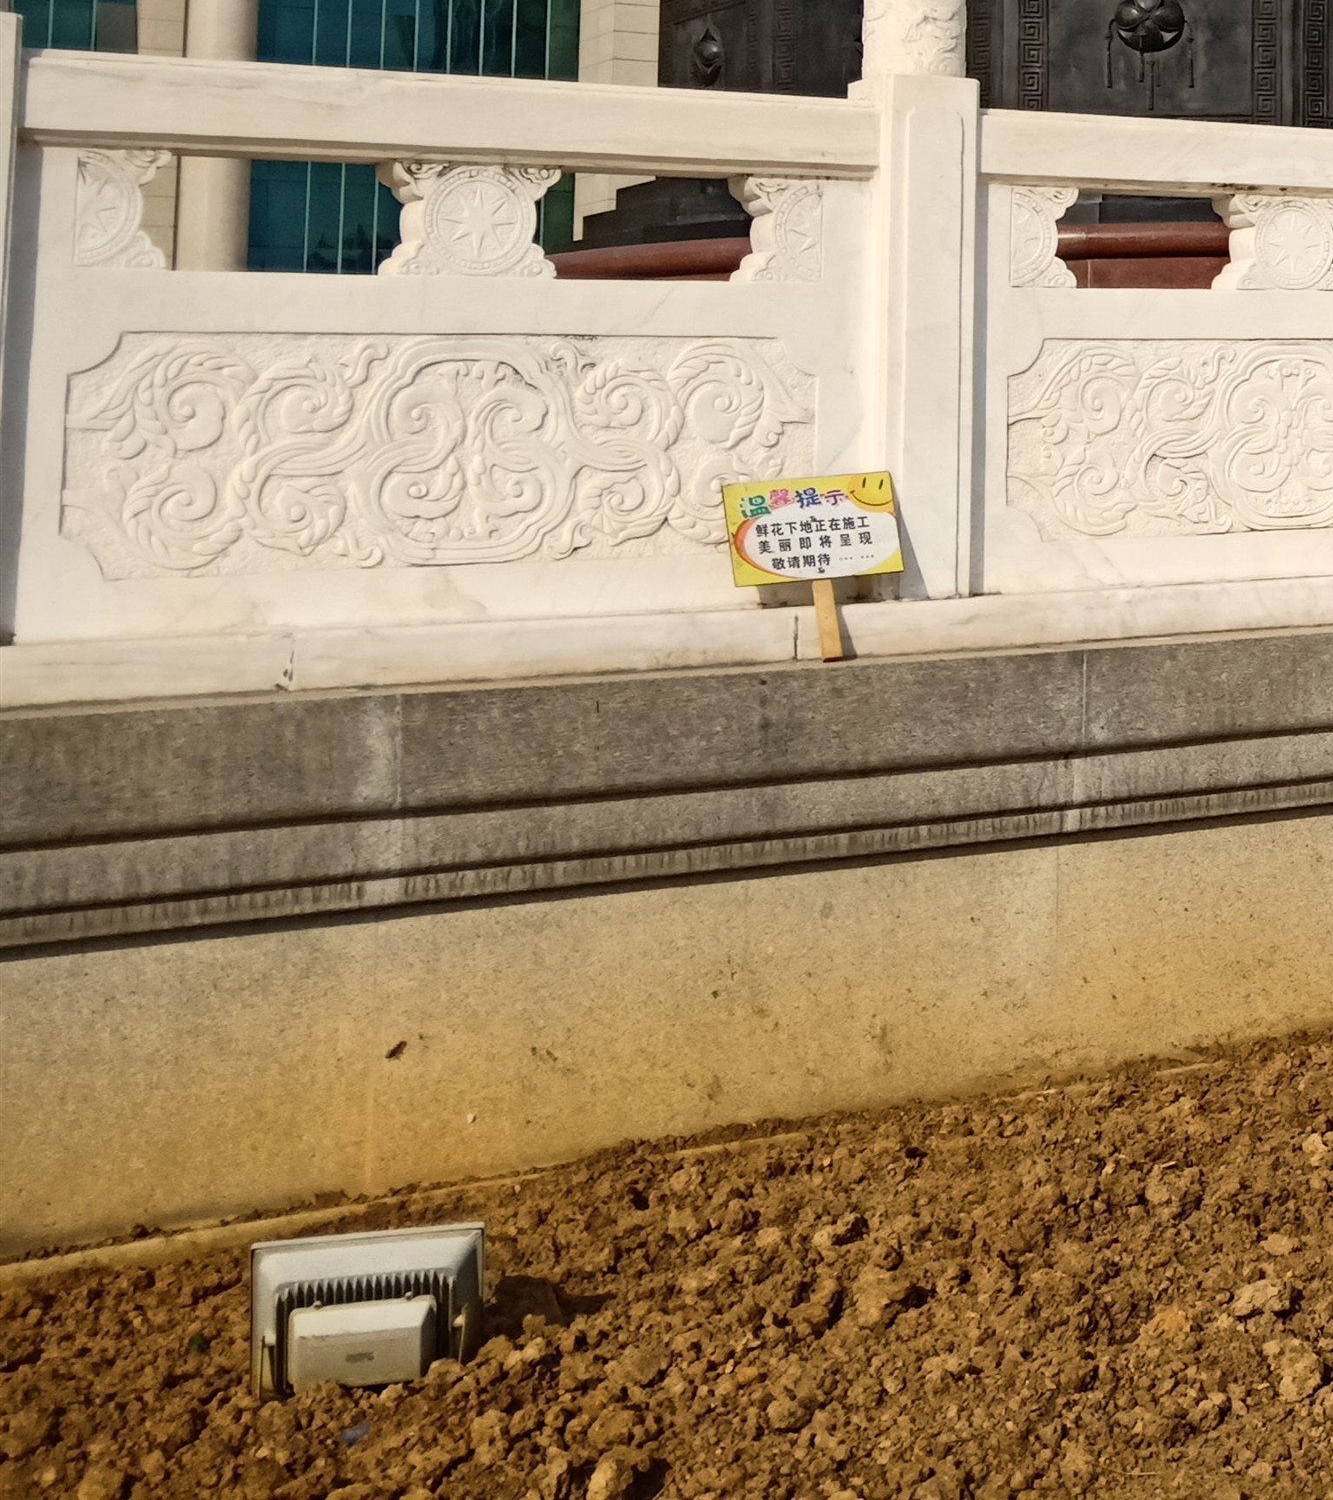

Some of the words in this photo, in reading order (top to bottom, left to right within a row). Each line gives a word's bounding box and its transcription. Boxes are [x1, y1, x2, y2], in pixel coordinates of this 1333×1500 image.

[740, 487, 845, 519] 温馨提示
[755, 516, 870, 537] 鲜花下地正在施工
[758, 532, 873, 554] 美丽即将呈现
